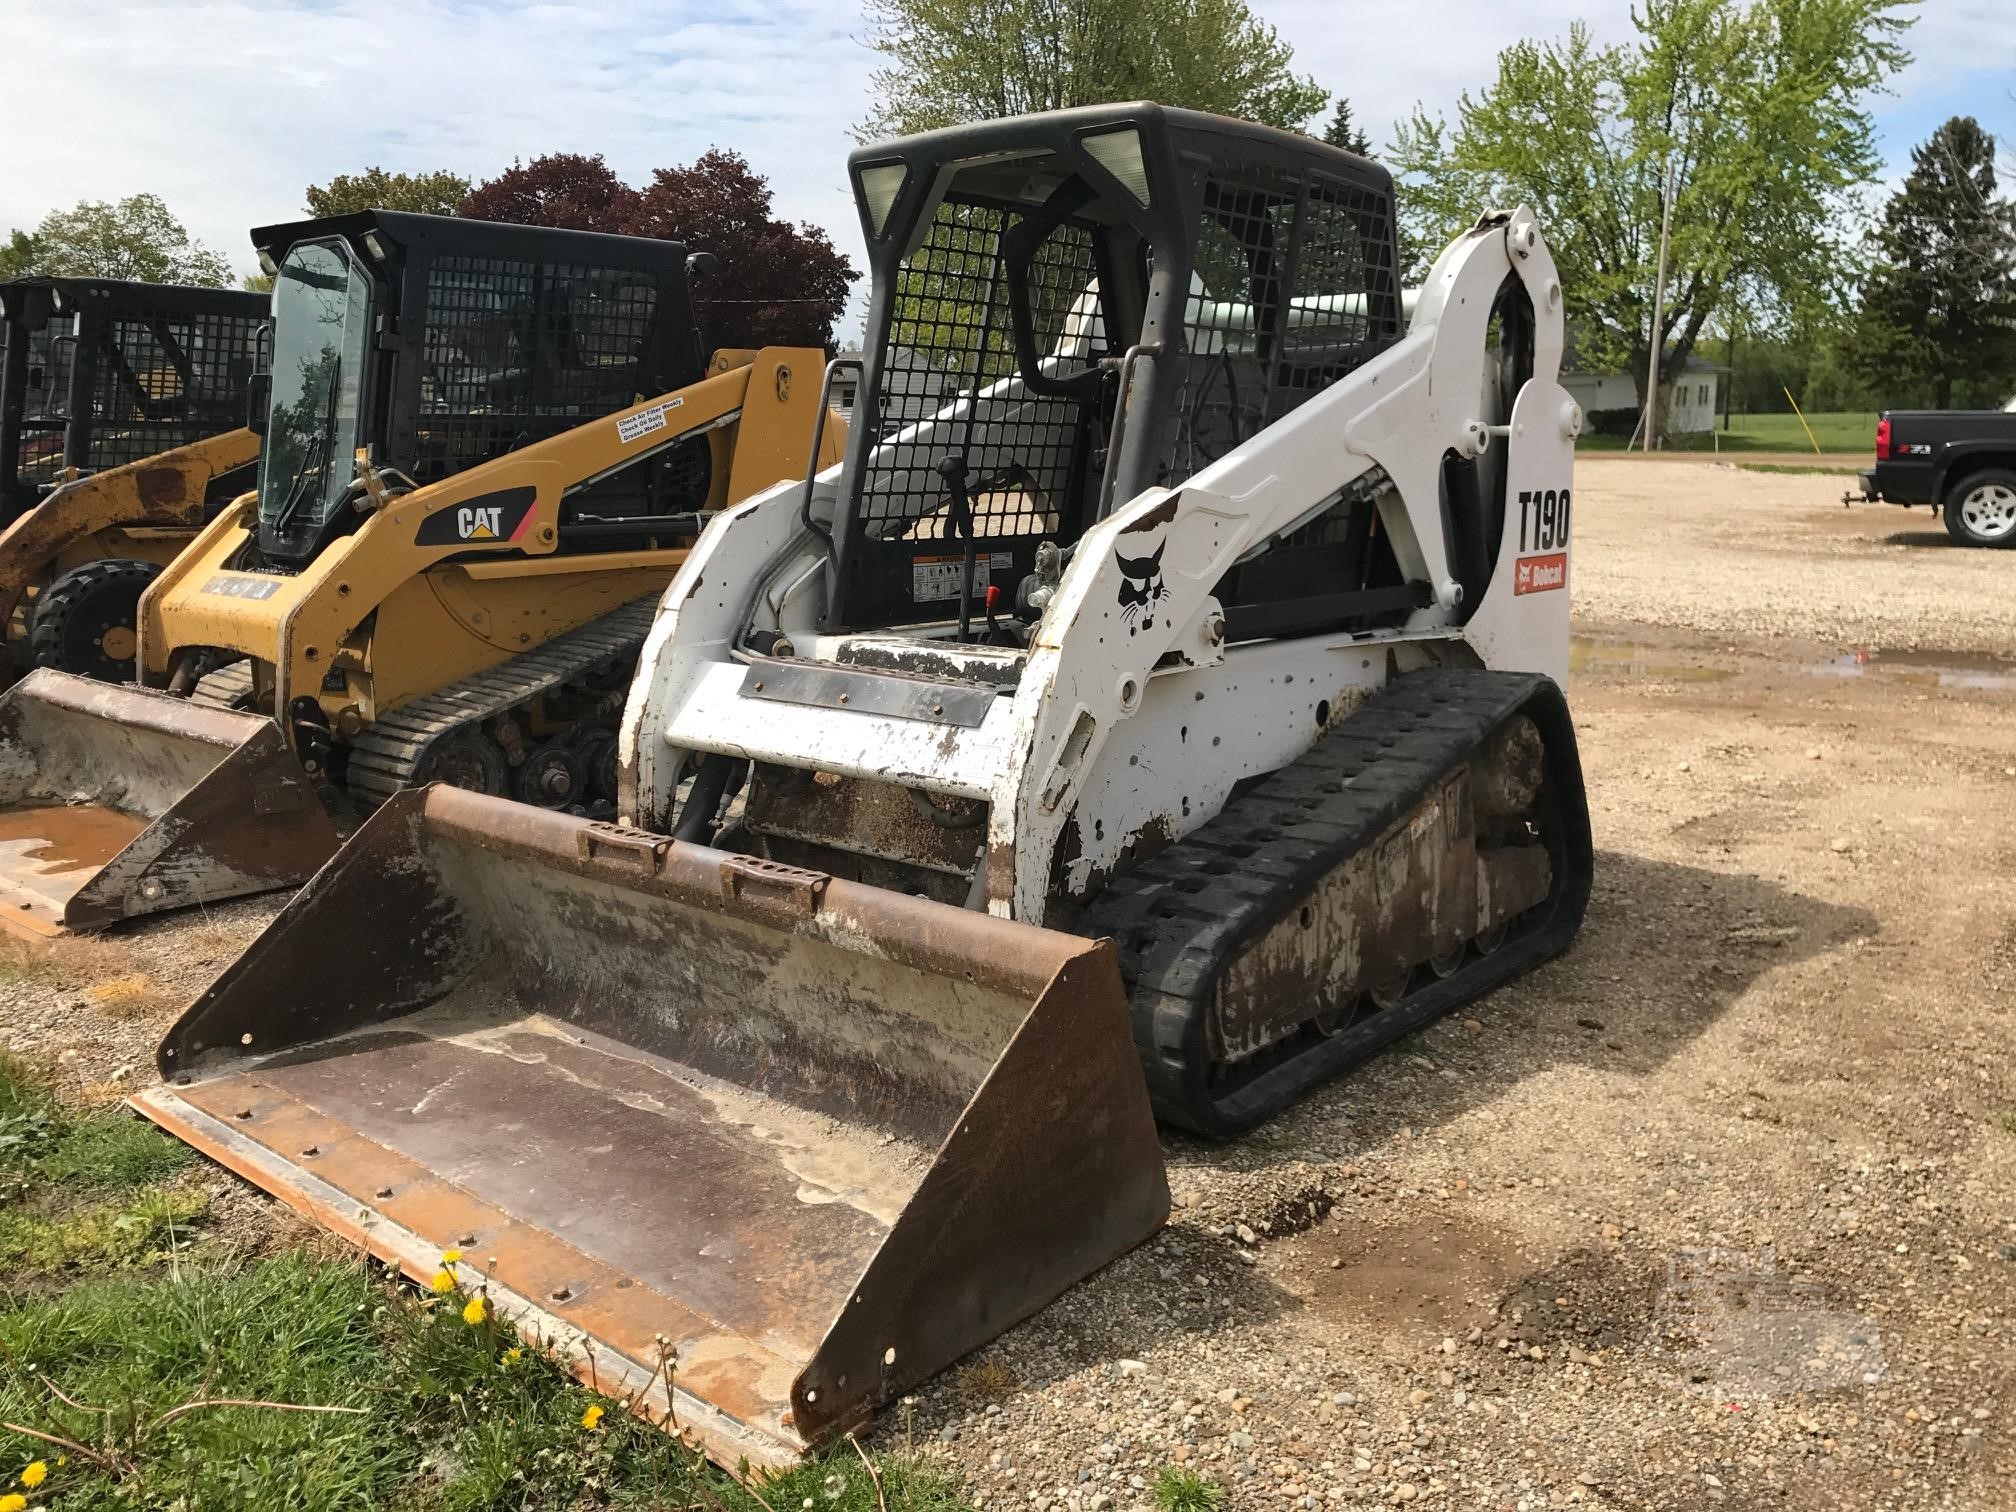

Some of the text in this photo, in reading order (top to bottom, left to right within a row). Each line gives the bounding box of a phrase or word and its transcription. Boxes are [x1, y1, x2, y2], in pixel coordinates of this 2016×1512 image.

[619, 416, 637, 427] Check
[646, 407, 661, 416] Filter
[661, 399, 682, 410] Weekly
[620, 423, 639, 434] Check
[648, 414, 662, 423] Daily
[623, 421, 664, 441] Grease Weekly
[457, 507, 502, 539] CAT
[1518, 489, 1571, 553] T190
[1532, 562, 1562, 587] Bobcat
